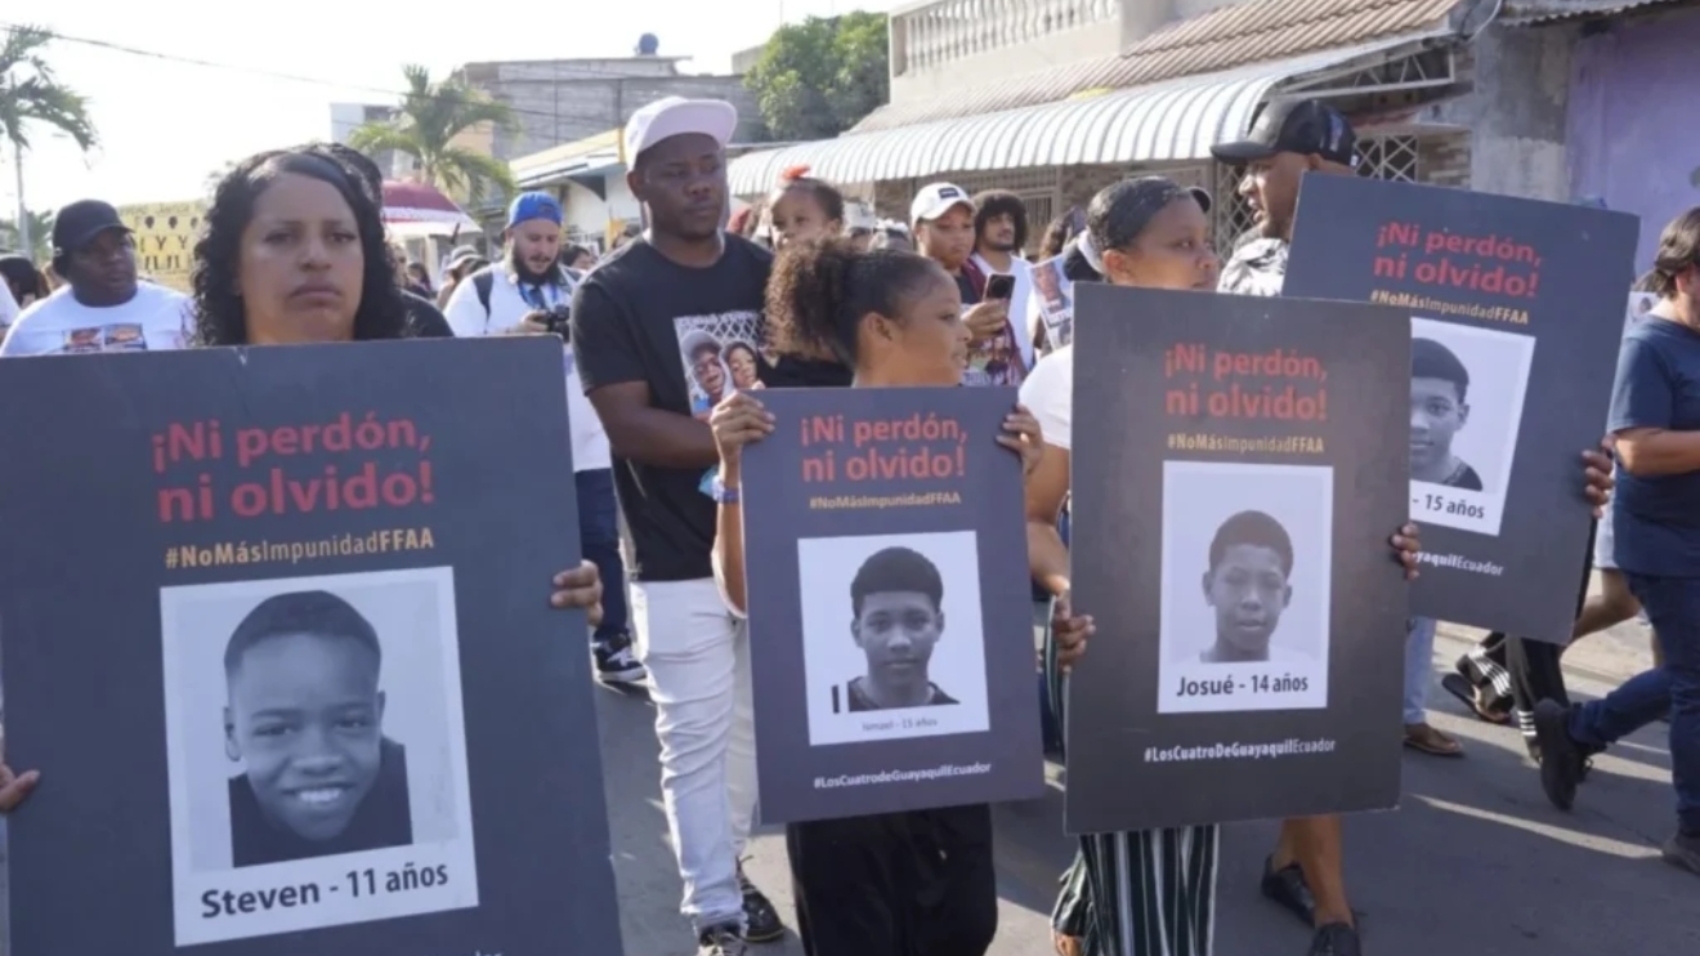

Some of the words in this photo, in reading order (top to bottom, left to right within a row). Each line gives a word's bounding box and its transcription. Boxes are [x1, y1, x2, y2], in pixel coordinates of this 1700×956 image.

[1377, 222, 1420, 247] ¡Ni
[1426, 231, 1542, 267] perdón,
[1374, 253, 1407, 279] ni
[1415, 257, 1539, 298] olvido!
[1370, 289, 1529, 324] #NoMásImpunidadFFAA
[1165, 343, 1206, 378] ¡Ni
[1213, 348, 1327, 381] perdón,
[1166, 382, 1198, 415] ni
[1209, 382, 1327, 421] olvido!
[152, 418, 222, 473] ¡Ni
[236, 411, 431, 467] perdón,
[802, 414, 844, 446] ¡Ni
[853, 412, 968, 448] perdón,
[1167, 433, 1325, 454] #NoMásImpunidadFFAA
[802, 450, 835, 482] ni
[846, 446, 966, 481] olvido!
[158, 472, 214, 522] ni
[231, 460, 434, 517] olvido!
[809, 491, 961, 509] #NoMásImpunidadFFAA
[1425, 494, 1443, 511] 15
[1446, 499, 1485, 519] años
[165, 527, 435, 568] #NoMásImpunidadFFAA
[1176, 674, 1234, 697] Josué
[1252, 675, 1269, 693] 14
[1272, 673, 1308, 693] años
[1144, 737, 1336, 763] #LosCuatroDeGuayaquilEcuador
[201, 881, 320, 918] Steven
[346, 868, 376, 898] 11
[385, 861, 449, 893] años
